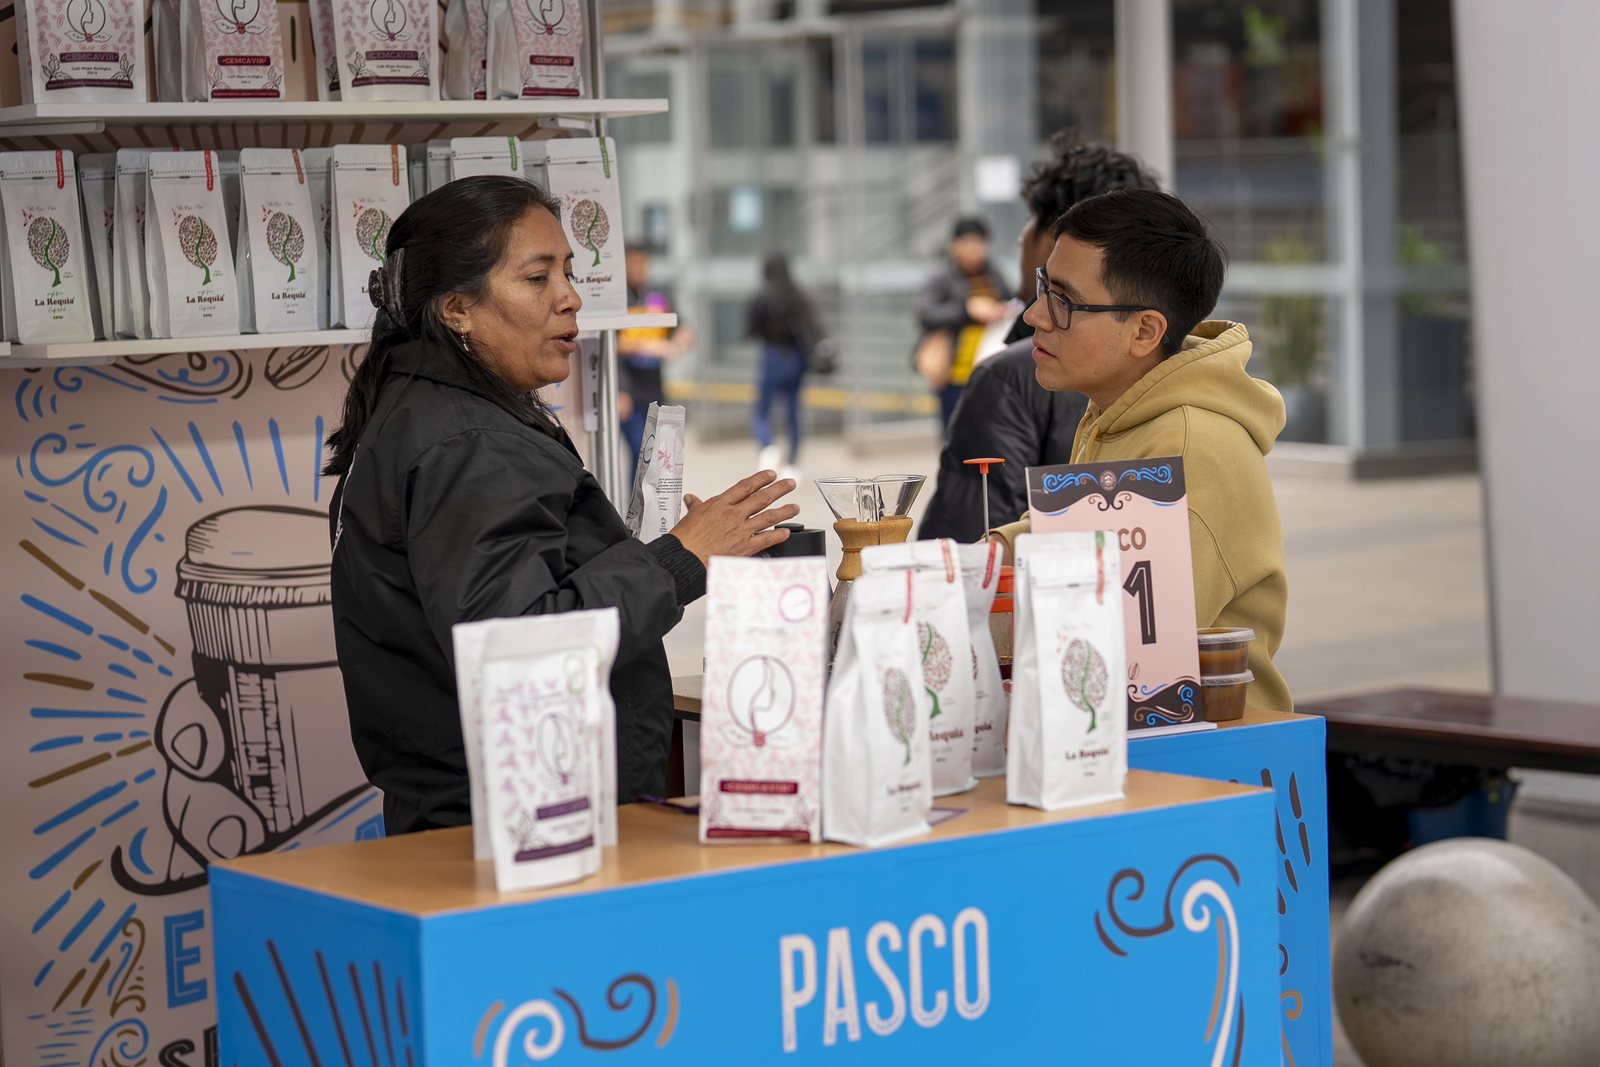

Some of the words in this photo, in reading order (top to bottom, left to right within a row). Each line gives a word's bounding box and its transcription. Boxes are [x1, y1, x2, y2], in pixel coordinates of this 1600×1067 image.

[271, 292, 281, 300] La
[1117, 526, 1147, 551] CO
[1122, 559, 1157, 645] 1
[779, 906, 991, 1053] PASCO
